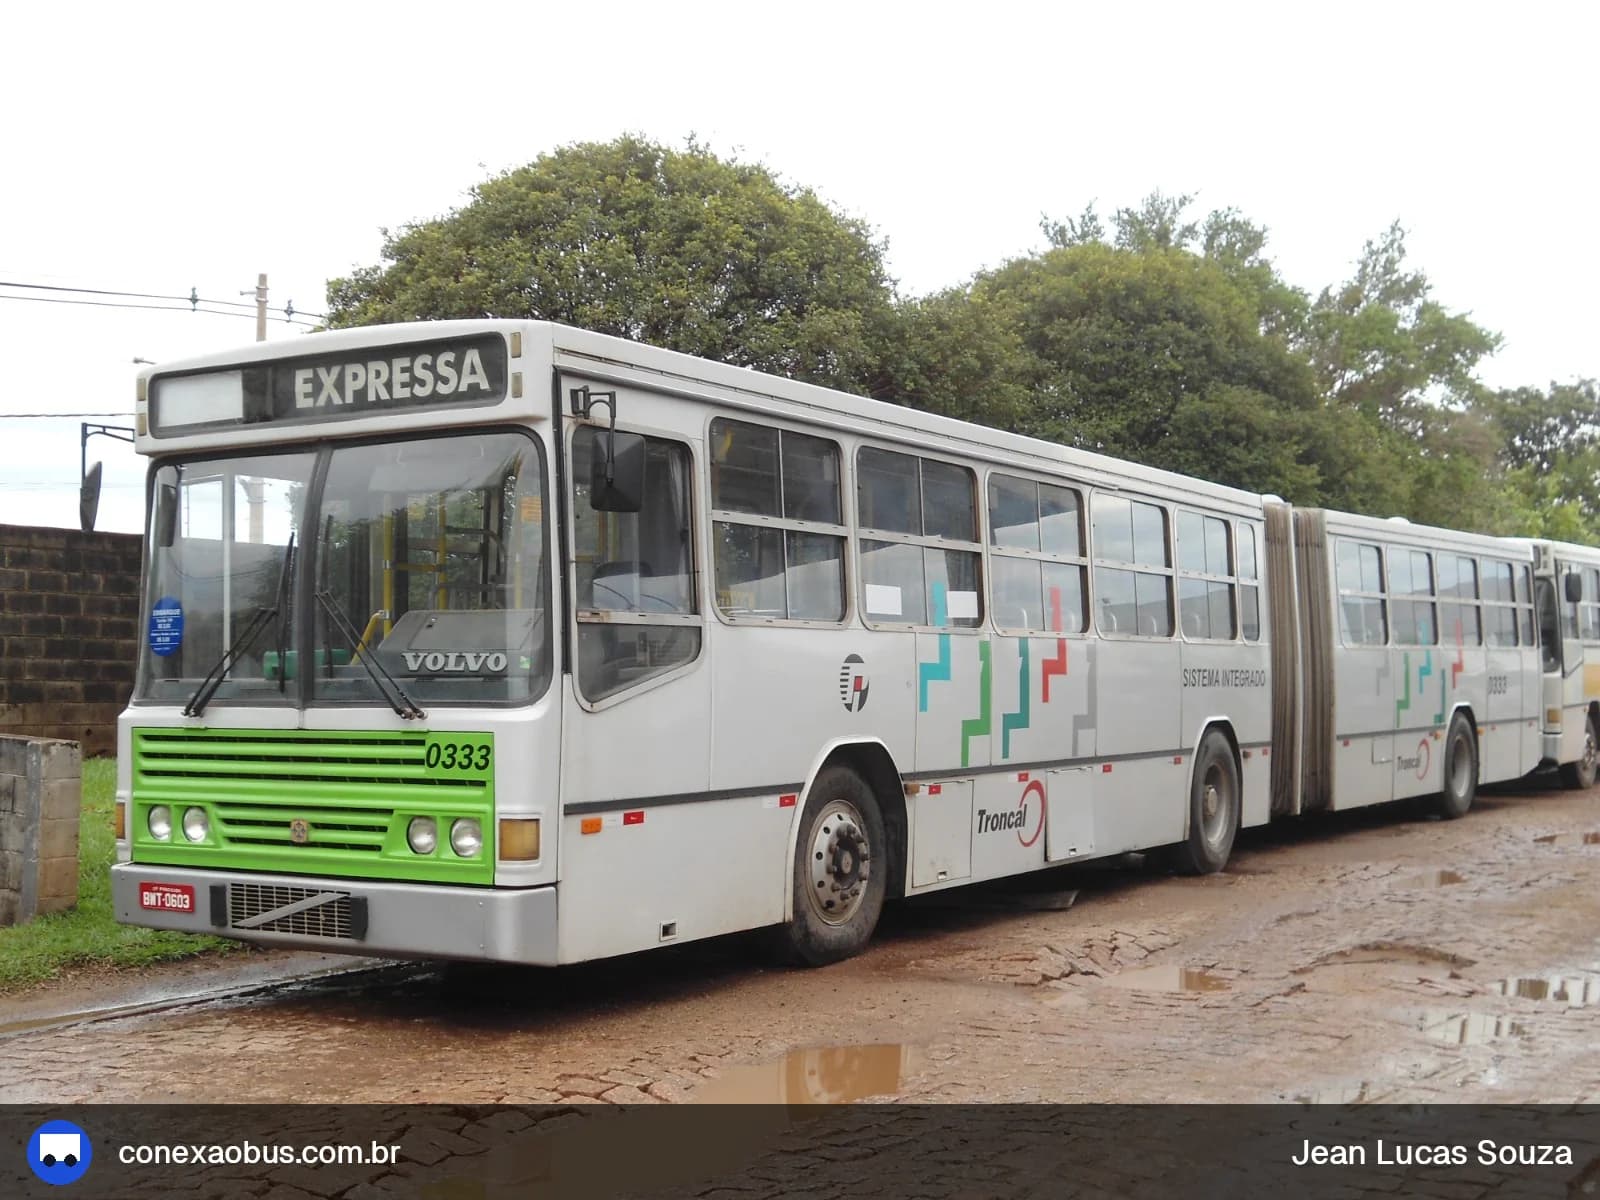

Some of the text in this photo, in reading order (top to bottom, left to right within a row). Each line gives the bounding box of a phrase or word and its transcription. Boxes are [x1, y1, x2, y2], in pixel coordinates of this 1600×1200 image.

[294, 348, 491, 409] EXPRESSA
[402, 652, 507, 672] VOLVO
[1183, 668, 1266, 688] SISTEMA INTEGRADO
[425, 742, 491, 770] 0333
[978, 803, 1027, 834] Troncal
[143, 891, 190, 909] BWT-0603
